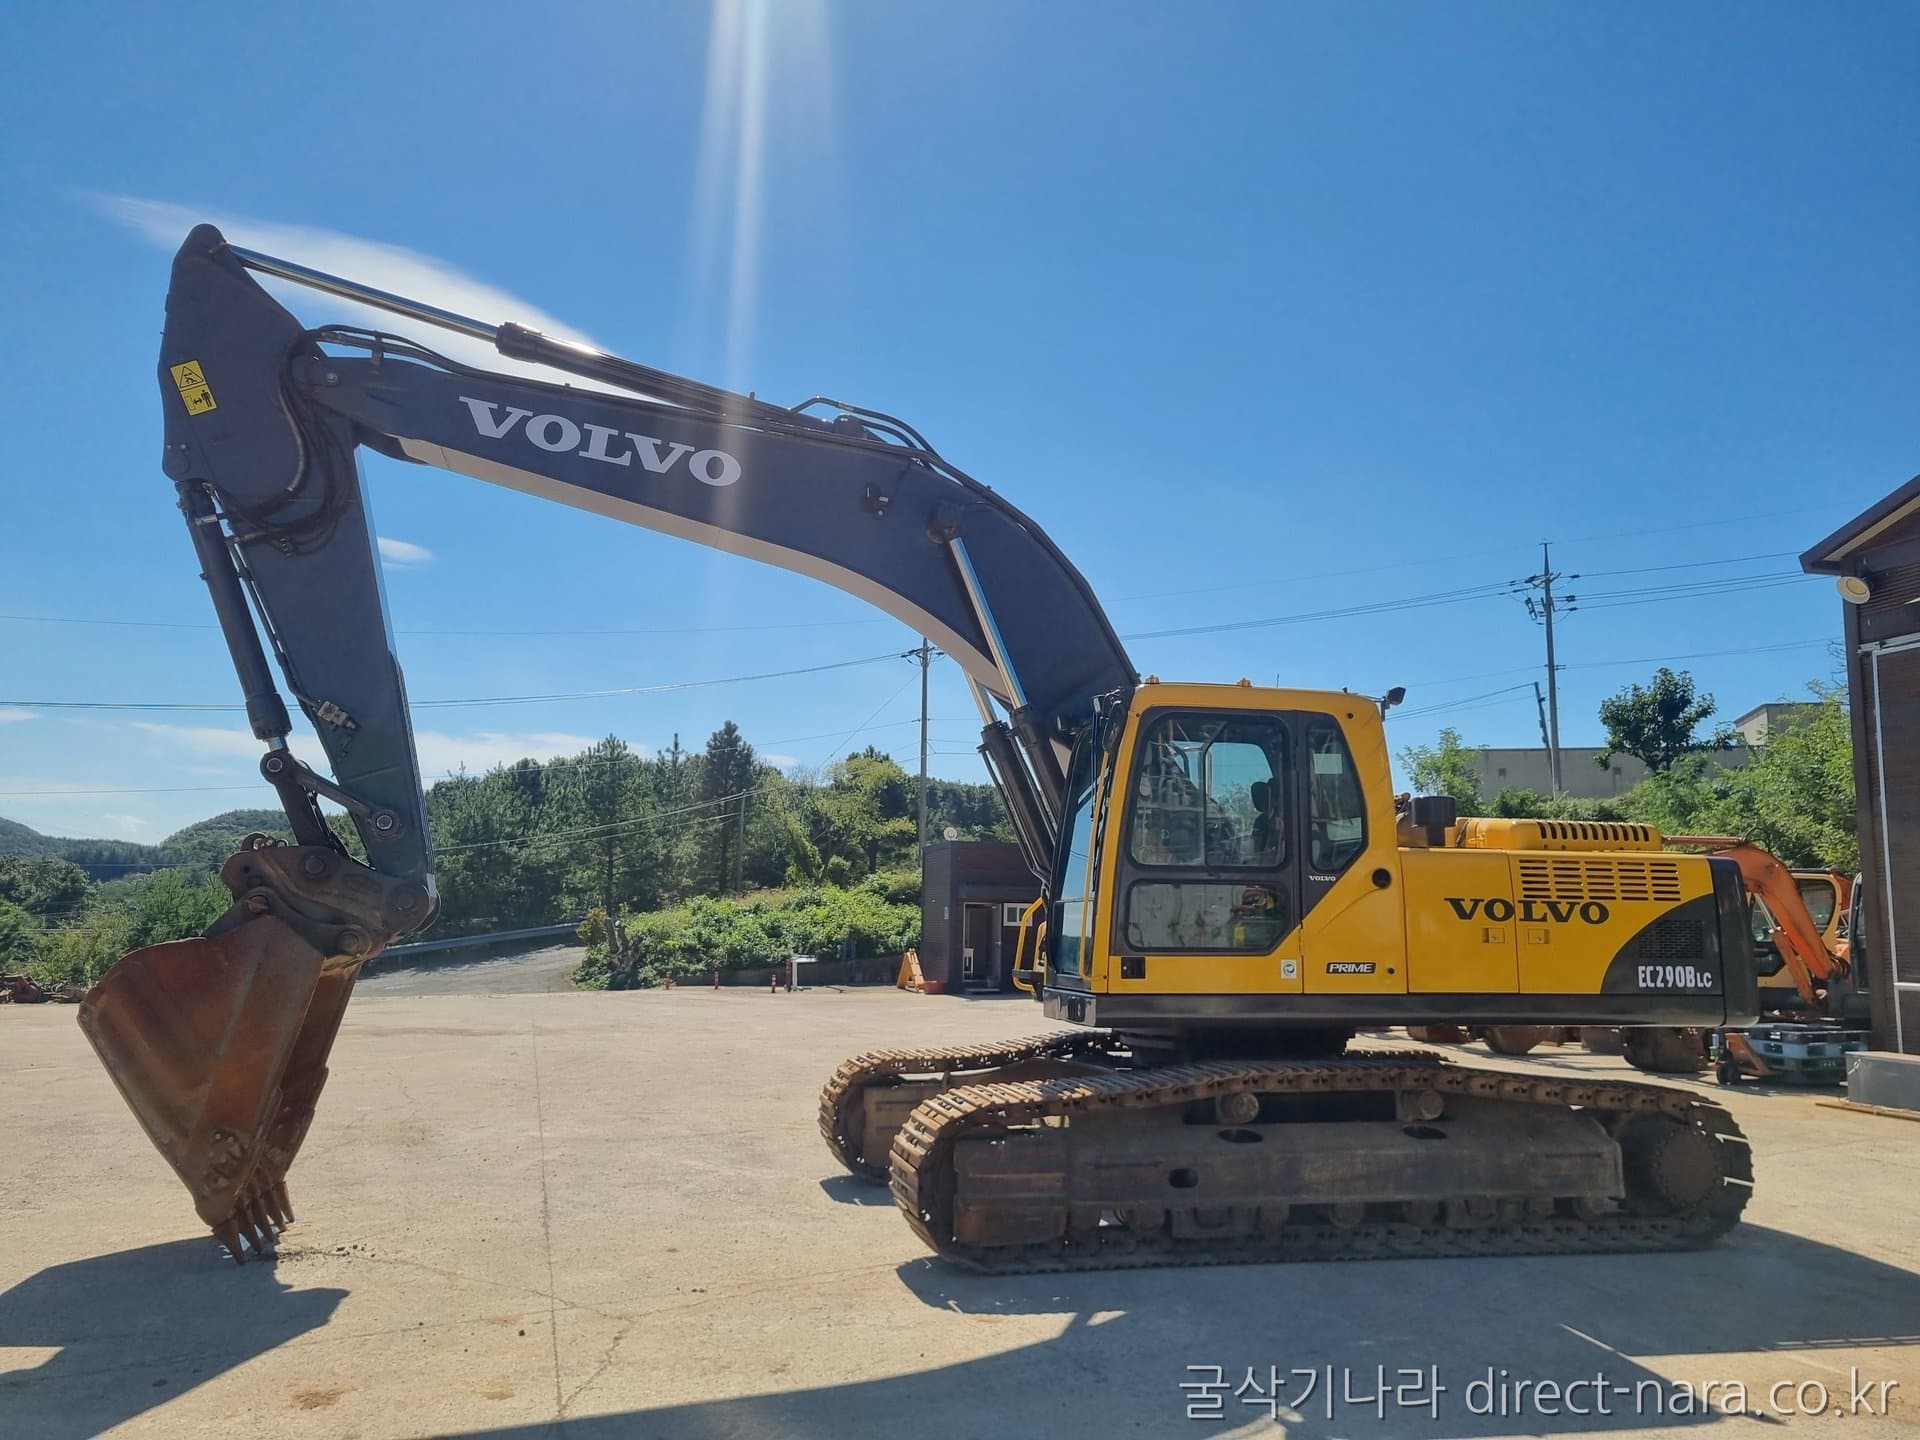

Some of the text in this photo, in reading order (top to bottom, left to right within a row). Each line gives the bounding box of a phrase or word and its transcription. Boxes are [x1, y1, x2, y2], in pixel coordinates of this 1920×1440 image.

[460, 396, 741, 487] VOLVO
[1444, 898, 1610, 924] VOLVO
[1329, 963, 1373, 973] PRIME
